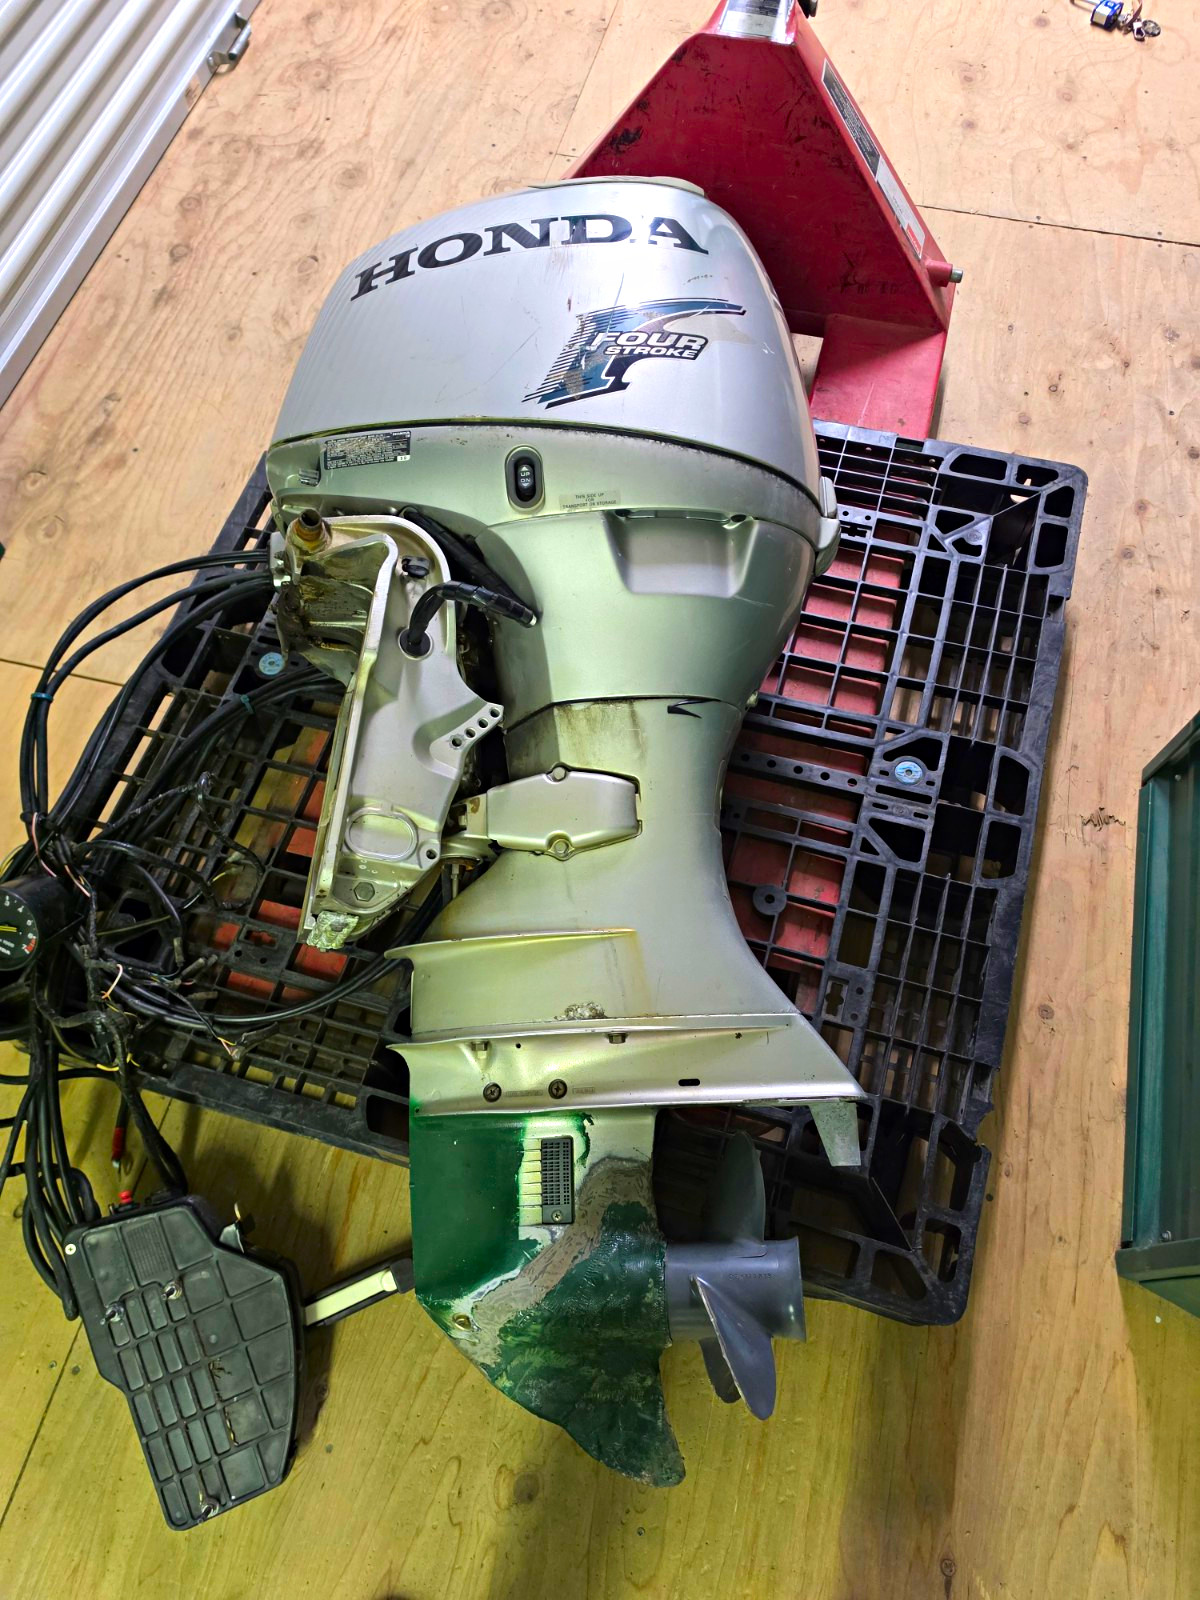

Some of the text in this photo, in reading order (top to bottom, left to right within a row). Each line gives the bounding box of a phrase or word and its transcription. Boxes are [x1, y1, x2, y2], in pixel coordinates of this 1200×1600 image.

[350, 213, 709, 302] HONDA
[587, 332, 707, 351] FOUR
[604, 346, 698, 359] STROKE
